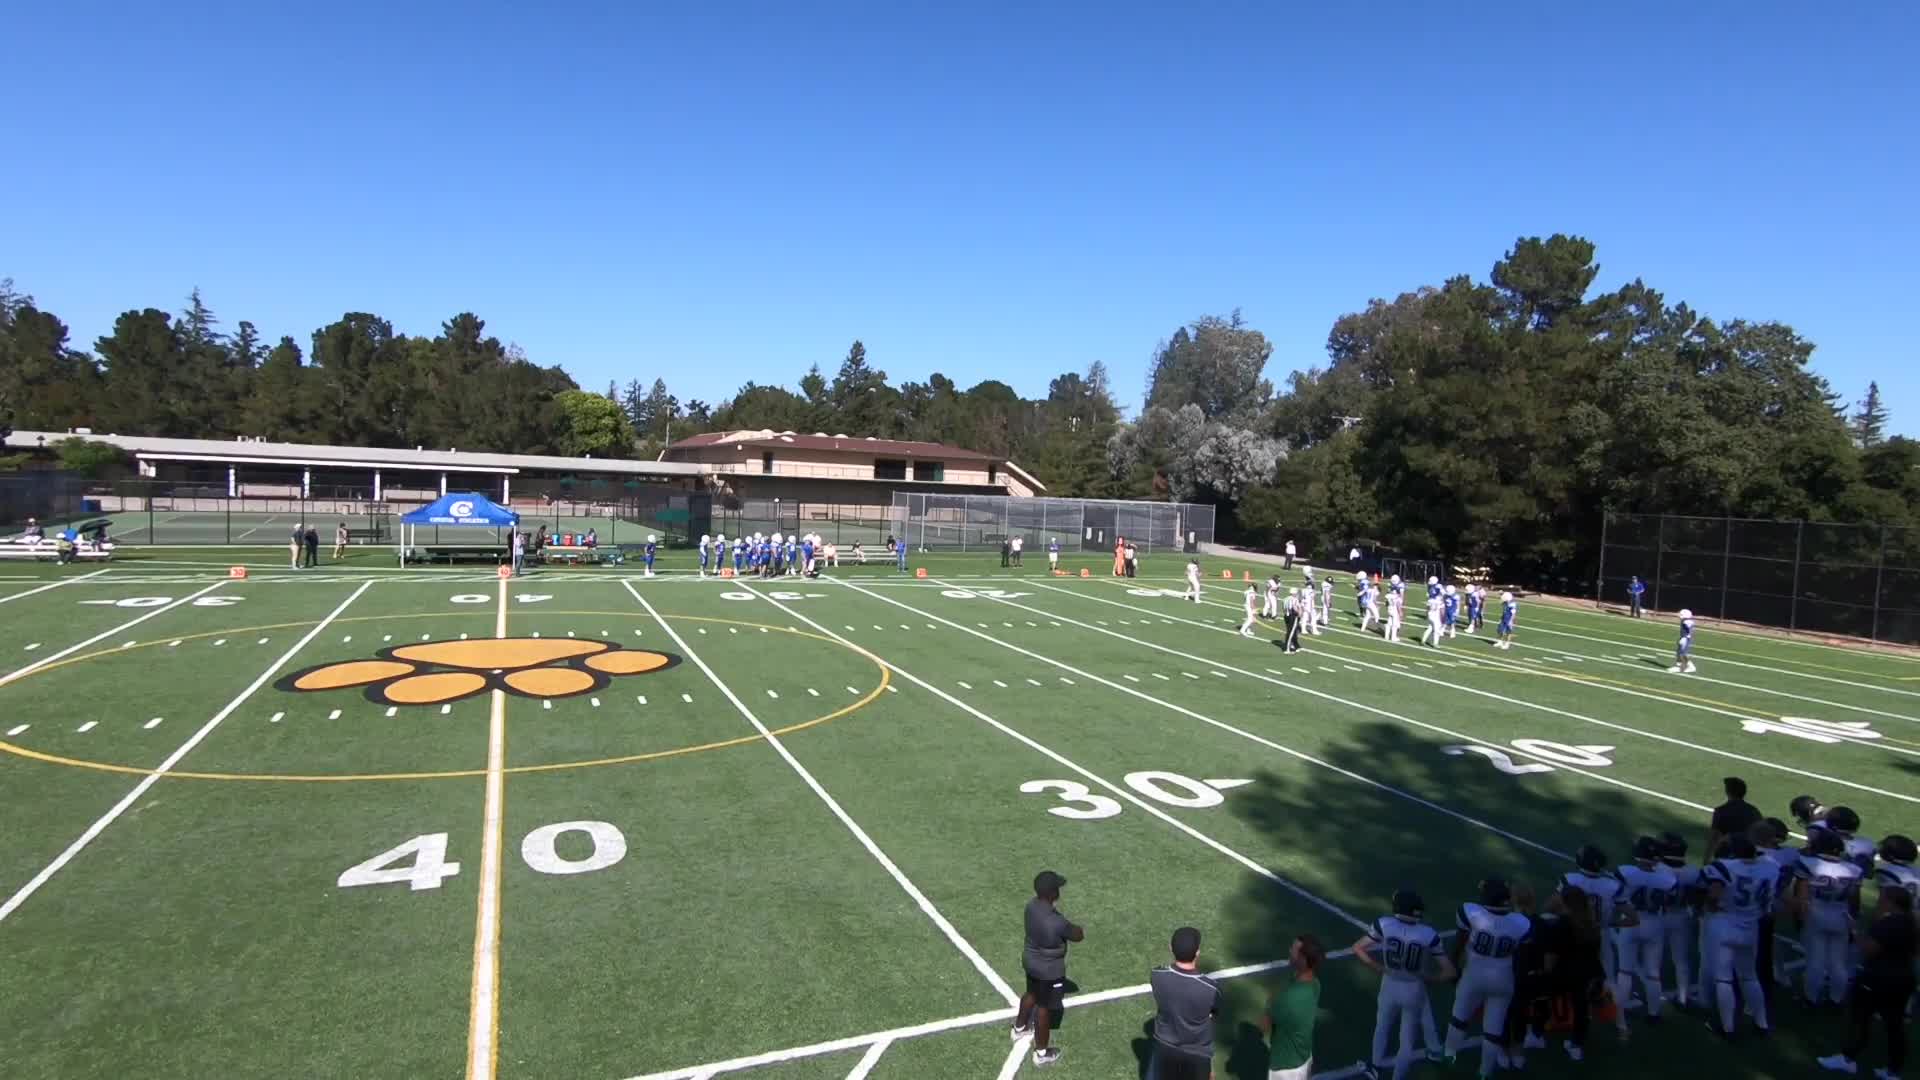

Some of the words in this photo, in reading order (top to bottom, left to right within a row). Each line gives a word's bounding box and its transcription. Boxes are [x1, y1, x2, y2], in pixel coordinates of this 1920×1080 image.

[1020, 771, 1224, 819] 30
[1736, 876, 1773, 907] 54
[1386, 937, 1422, 972] 20
